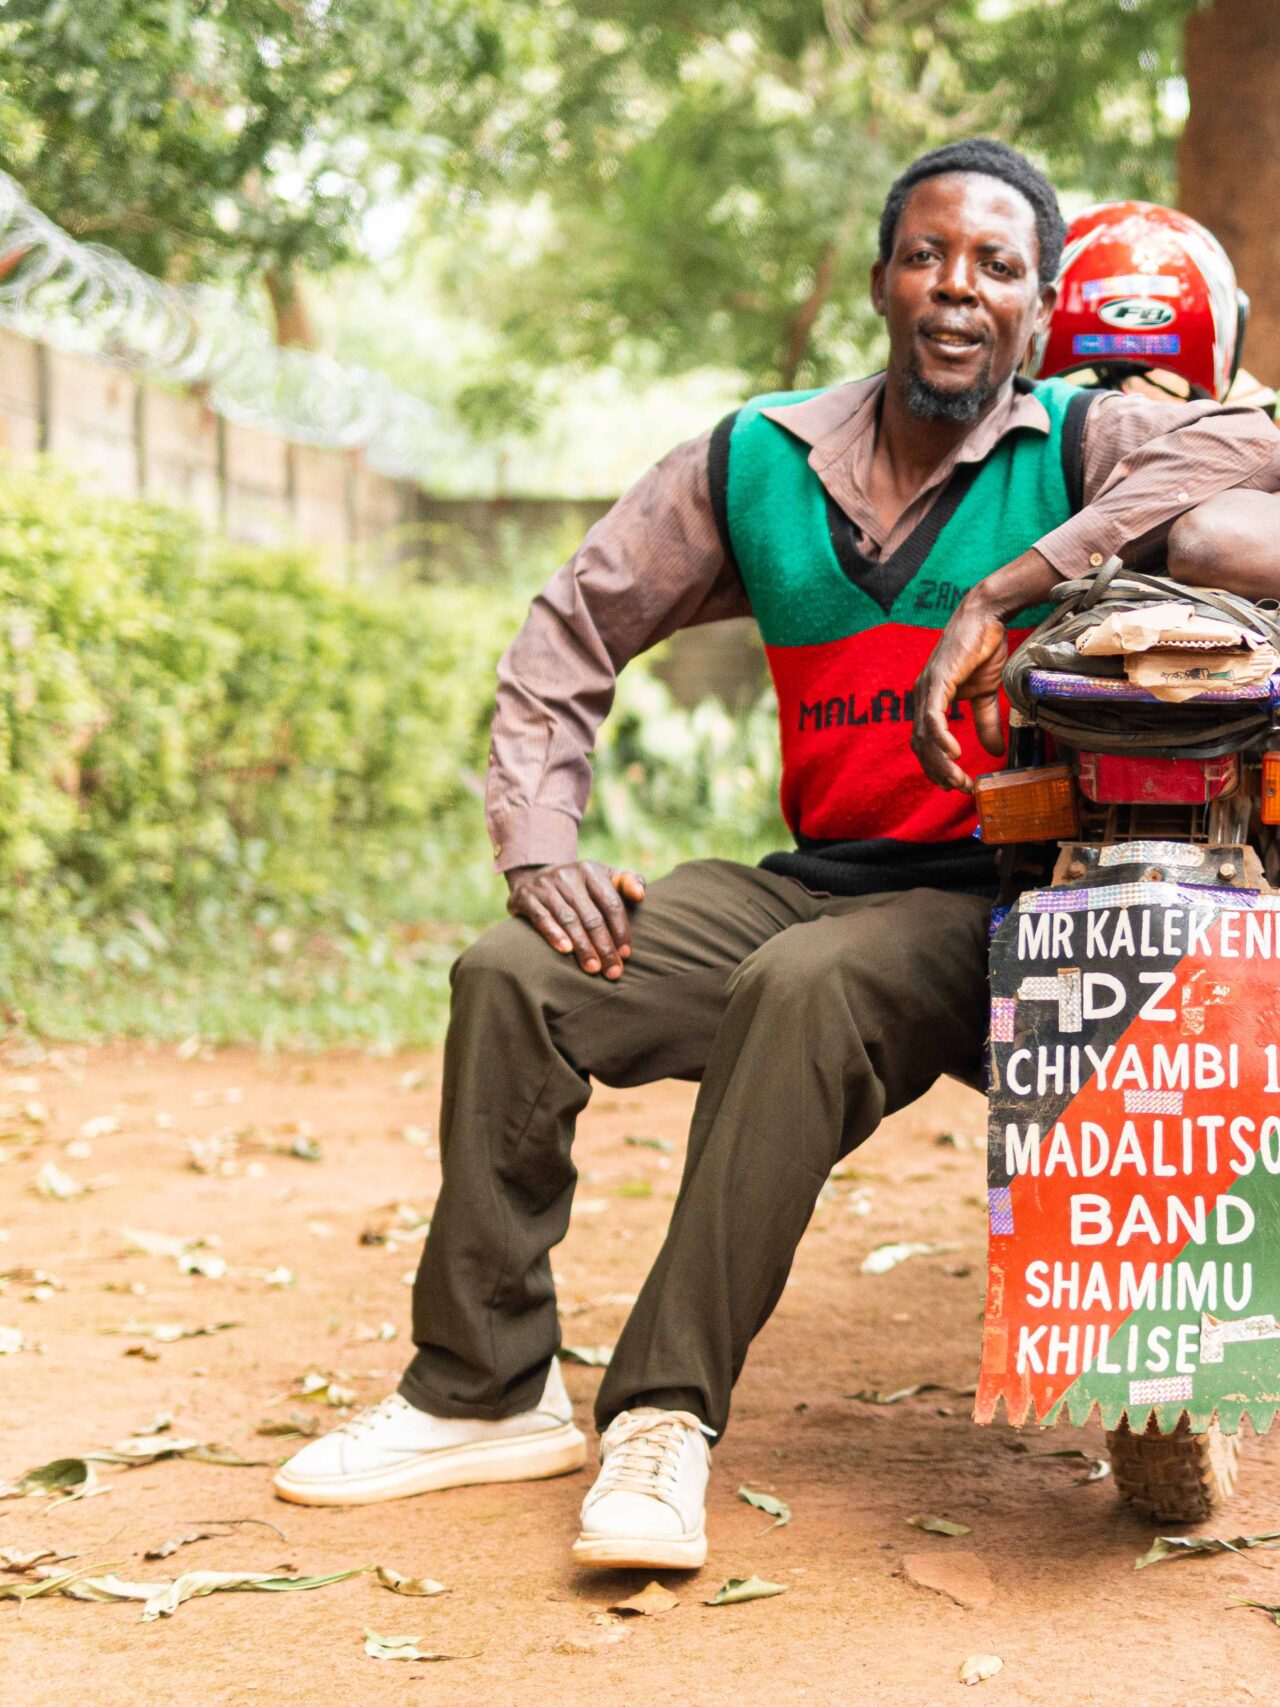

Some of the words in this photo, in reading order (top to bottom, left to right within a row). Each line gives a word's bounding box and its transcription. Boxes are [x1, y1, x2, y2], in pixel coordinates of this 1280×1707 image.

[1017, 911, 1074, 960] MR
[1006, 1044, 1238, 1095] CHIYAMBI
[1070, 1193, 1255, 1247] BAND
[1025, 1260, 1252, 1311] SHAMIMU
[1016, 1323, 1201, 1375] KHILISE
